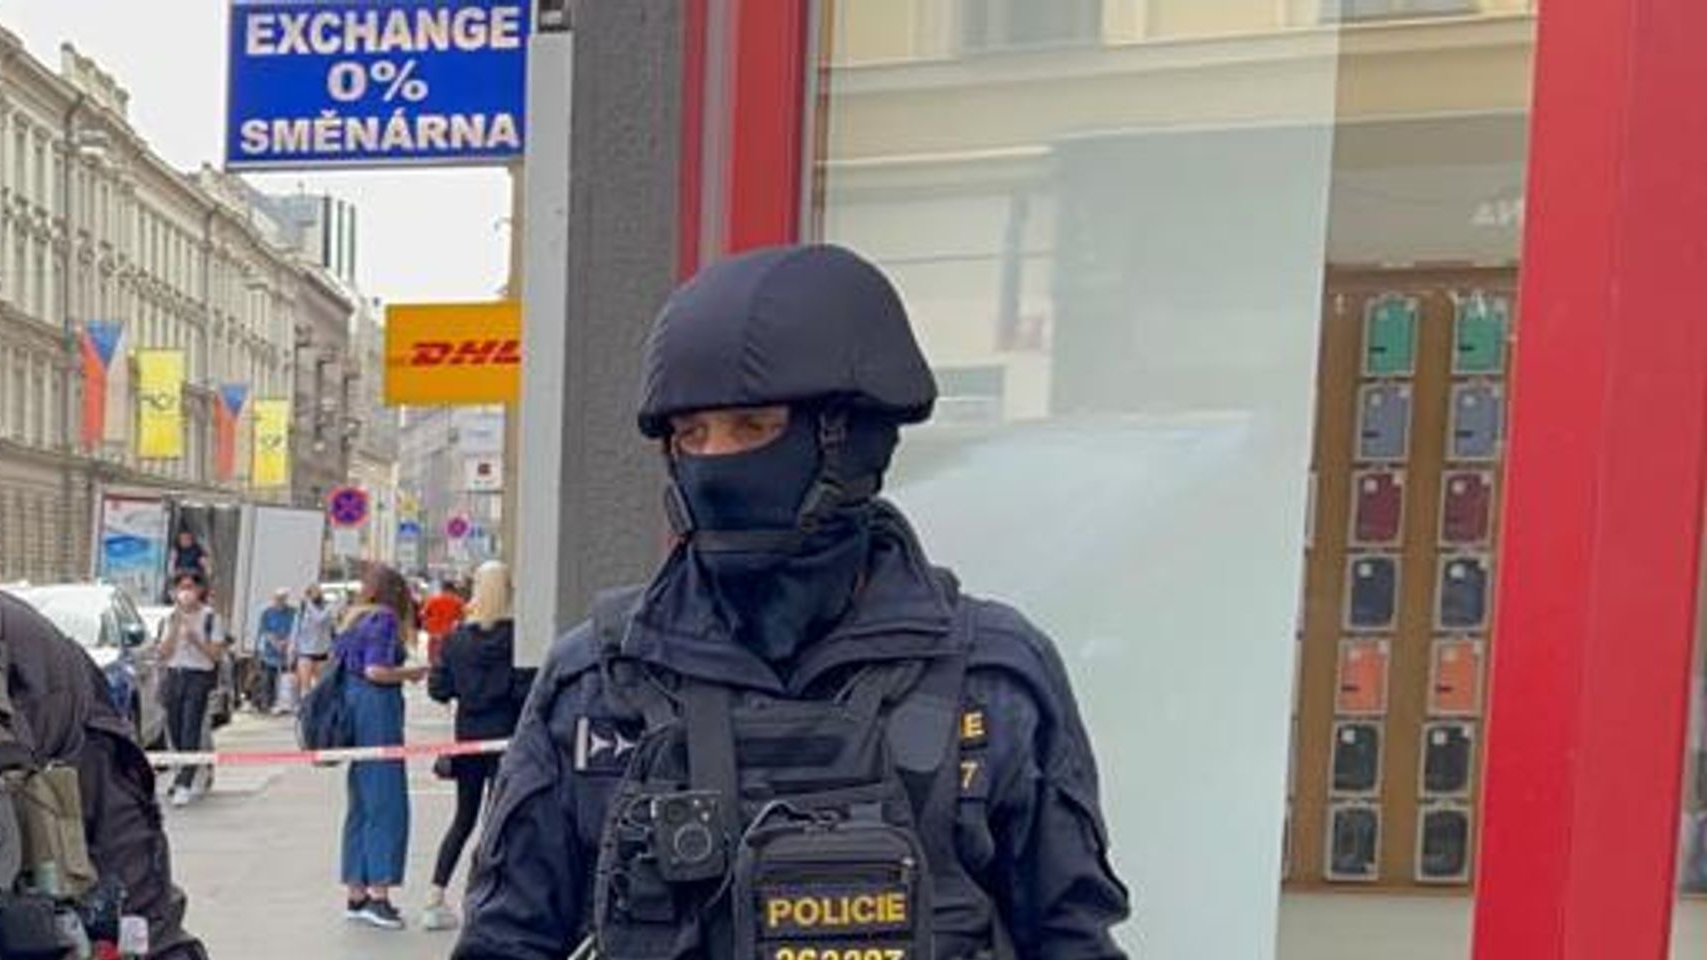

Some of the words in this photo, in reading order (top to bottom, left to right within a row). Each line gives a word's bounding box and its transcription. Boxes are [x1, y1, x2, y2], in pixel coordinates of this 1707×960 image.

[247, 7, 520, 54] EXCHANGE
[327, 60, 428, 101] 0%
[240, 108, 519, 153] SMĚNÁRNA
[411, 341, 520, 365] DHL
[768, 893, 905, 927] POLICIE
